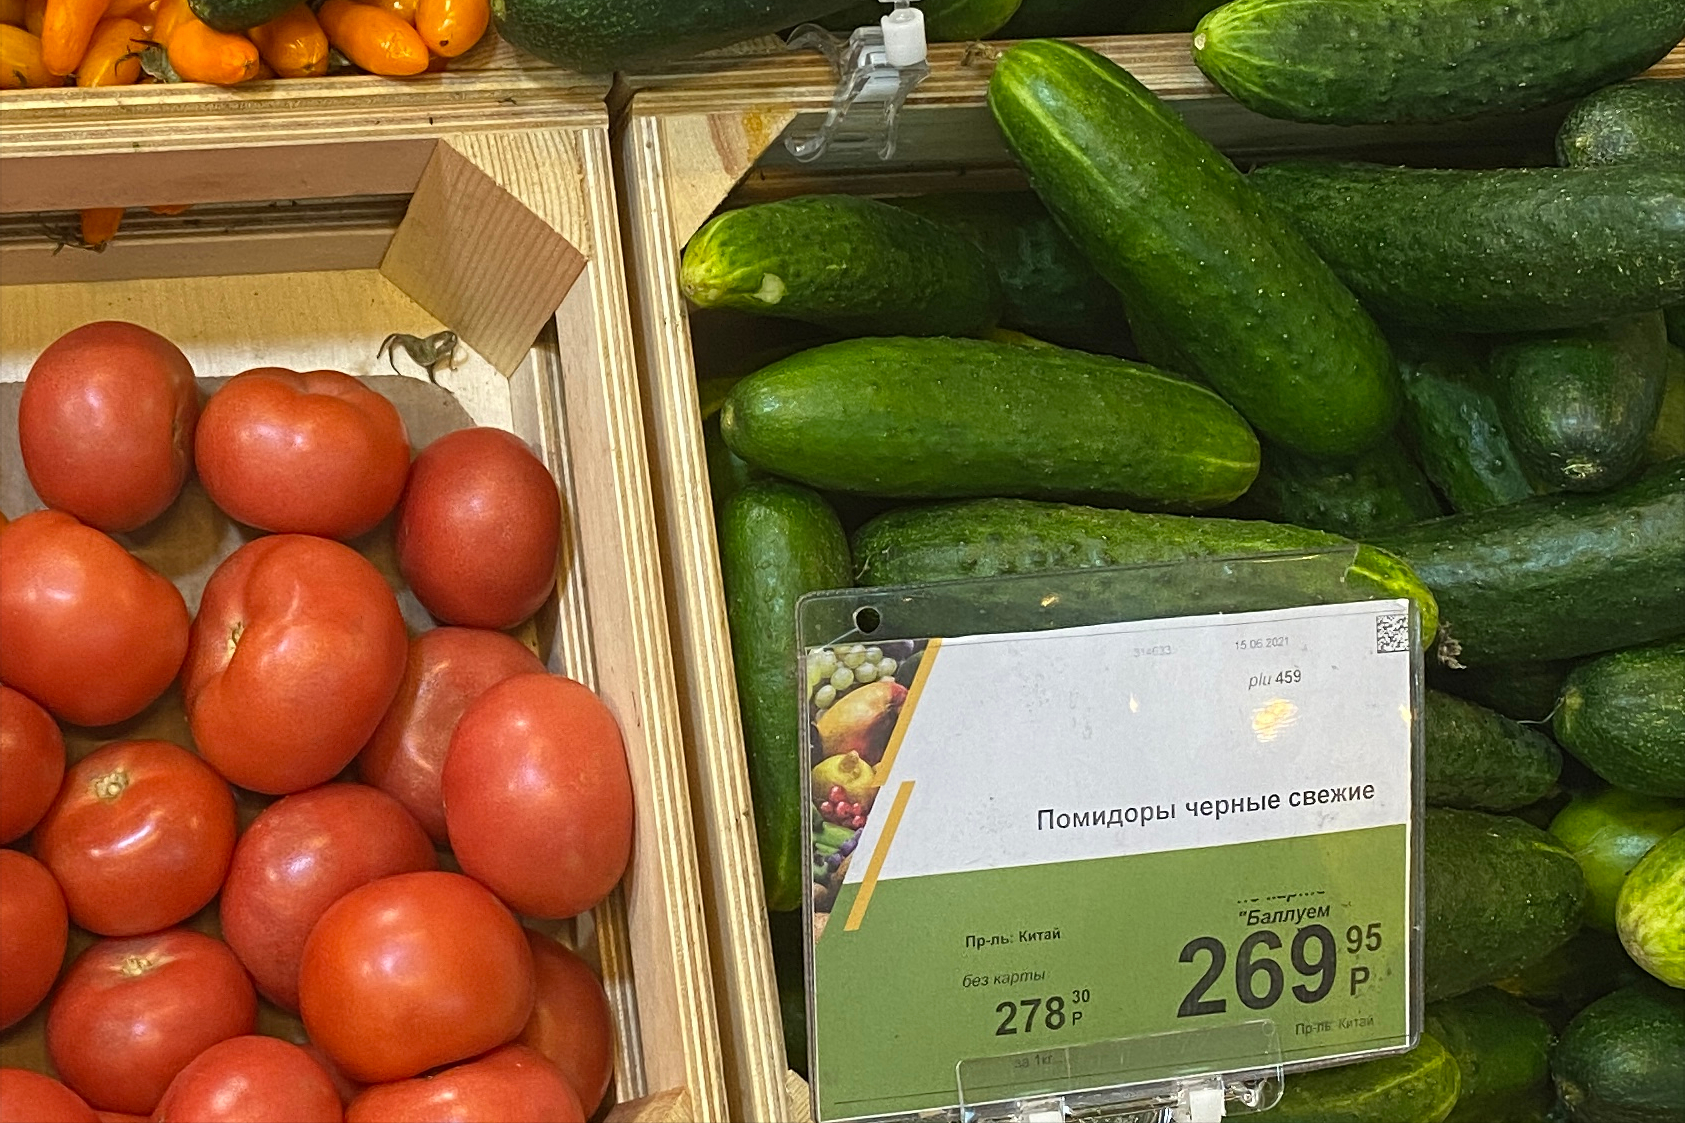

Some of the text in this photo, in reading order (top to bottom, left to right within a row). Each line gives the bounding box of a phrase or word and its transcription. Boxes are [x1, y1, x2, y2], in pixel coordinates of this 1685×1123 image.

[1248, 669, 1302, 690] plu 459
[1037, 783, 1376, 830] Помидоры черные свежие
[965, 927, 1061, 950] Пр-ль: Китай
[962, 970, 1046, 988] без карты
[1177, 922, 1382, 1018] 269 95
[995, 989, 1090, 1036] 278 30
[1338, 1015, 1374, 1029] Китай
